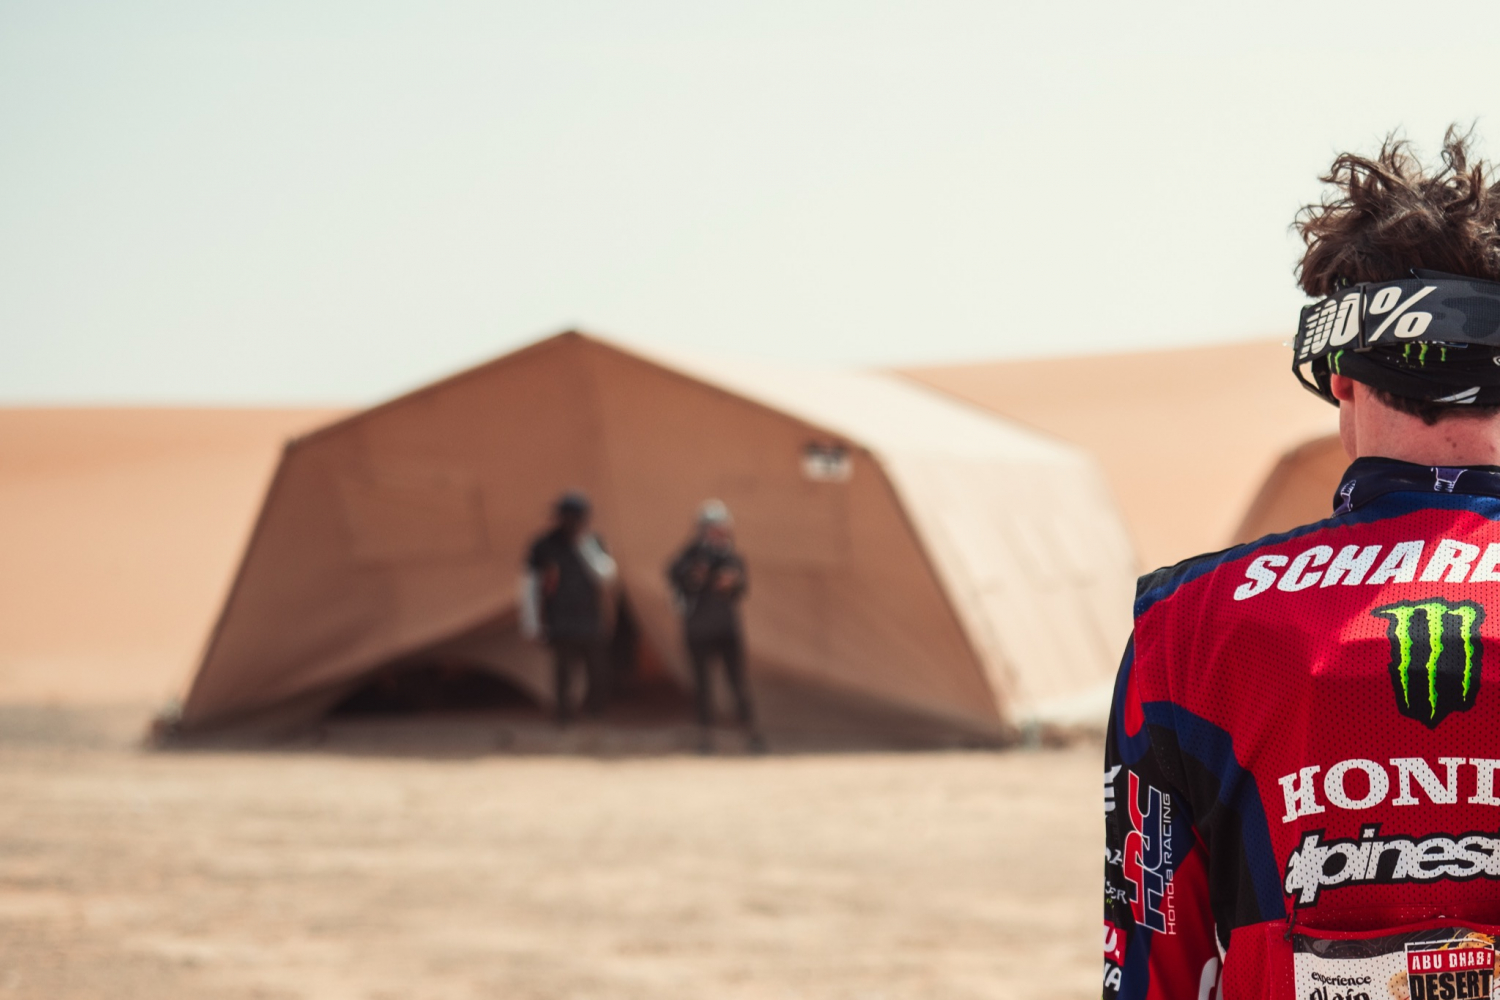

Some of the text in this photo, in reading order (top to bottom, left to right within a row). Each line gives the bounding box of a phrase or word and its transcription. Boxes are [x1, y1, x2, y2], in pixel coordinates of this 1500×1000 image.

[1298, 286, 1437, 360] 100%
[1162, 793, 1177, 935] Honda RACING
[1311, 971, 1372, 986] experience
[1412, 951, 1492, 970] ABU DHABI
